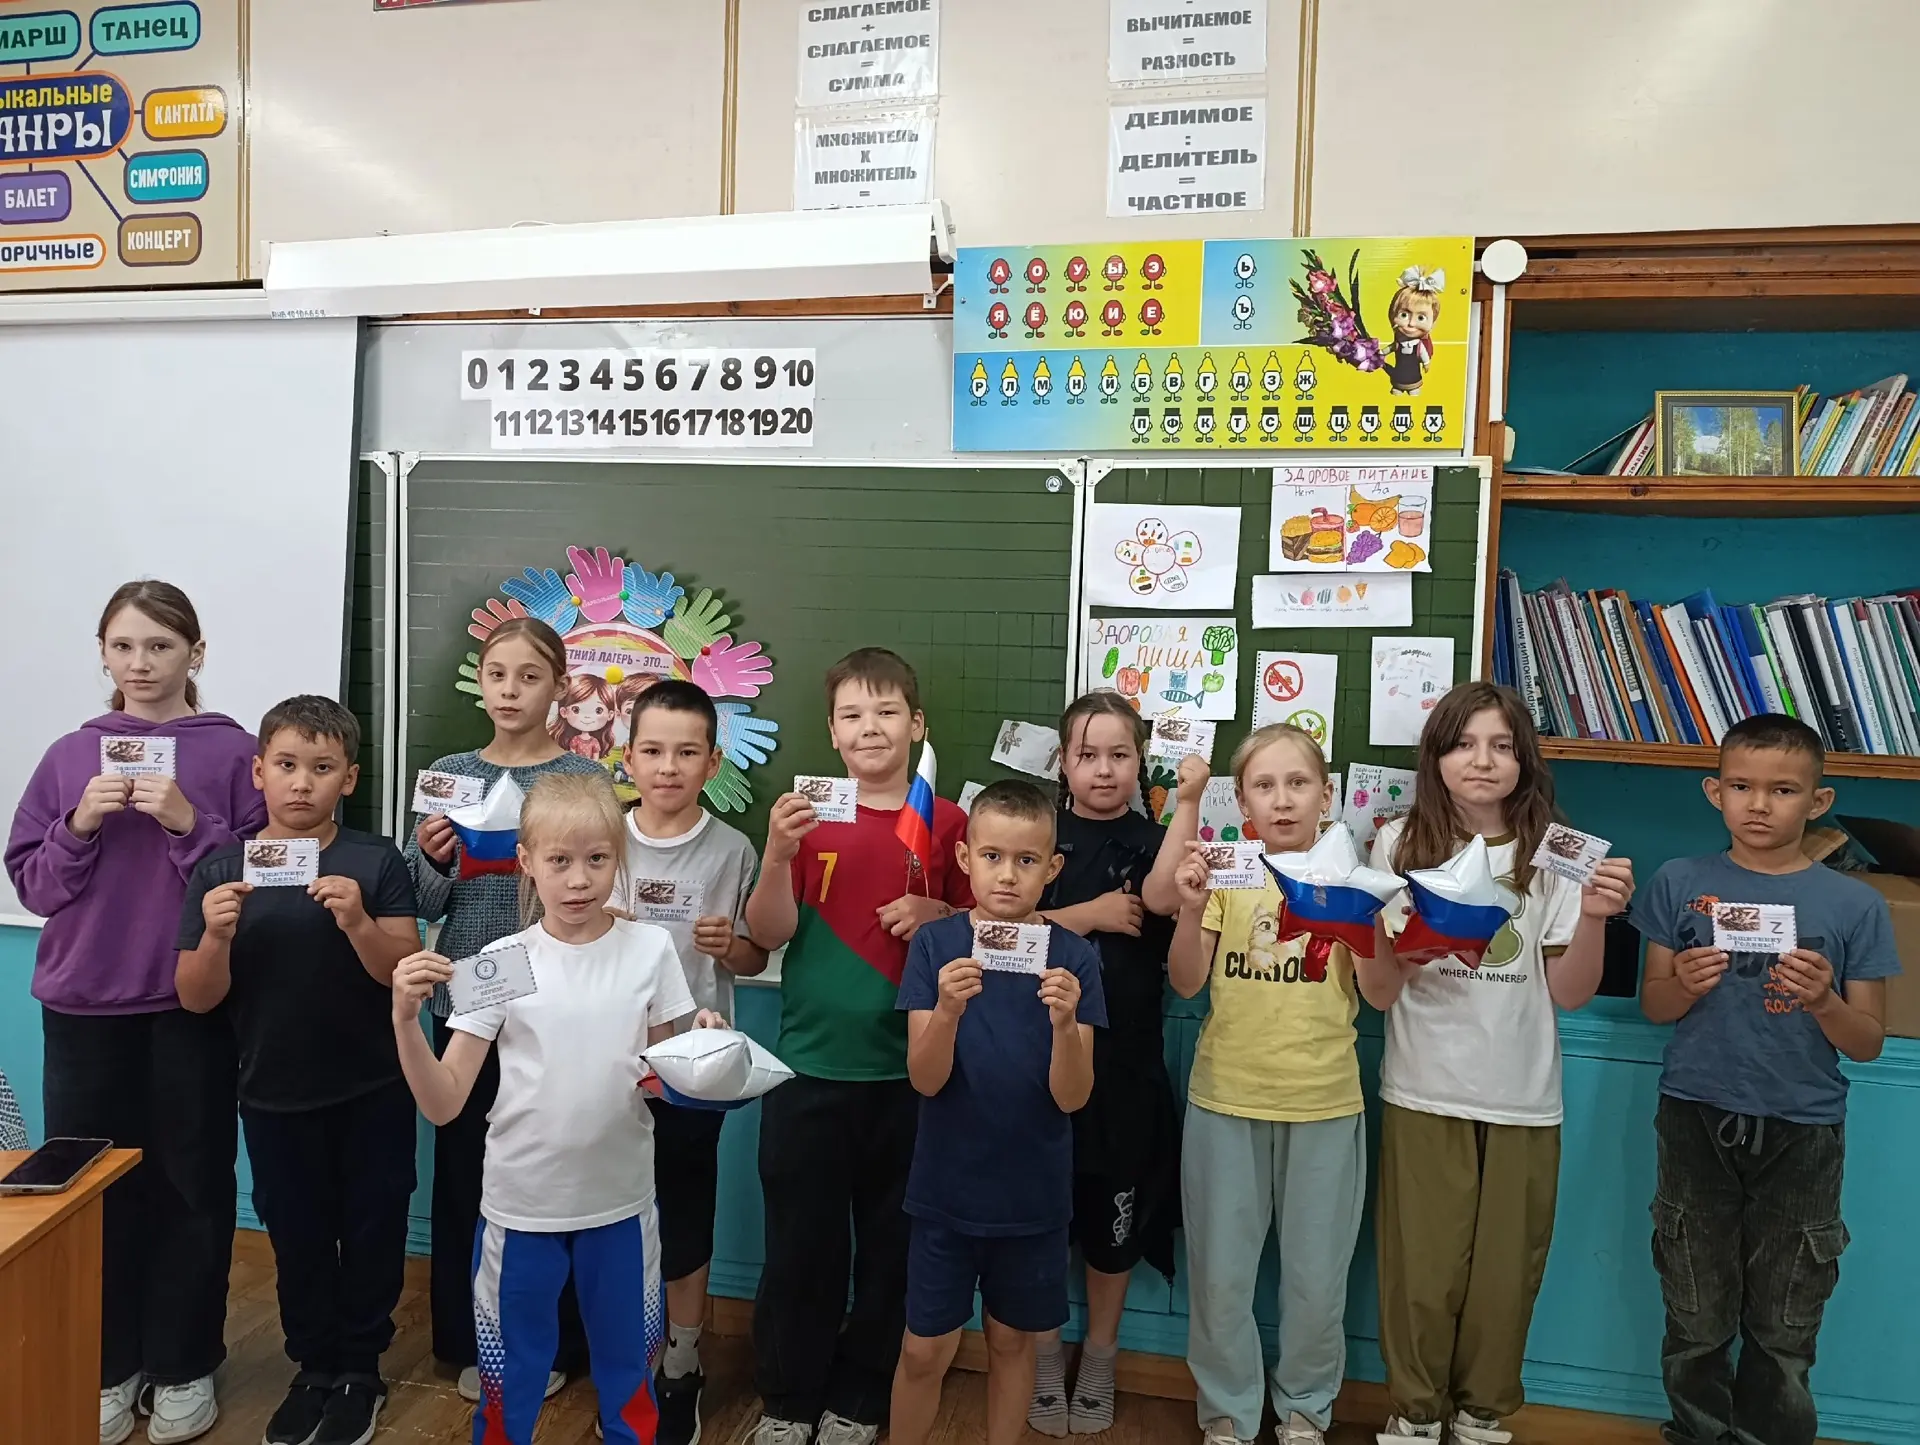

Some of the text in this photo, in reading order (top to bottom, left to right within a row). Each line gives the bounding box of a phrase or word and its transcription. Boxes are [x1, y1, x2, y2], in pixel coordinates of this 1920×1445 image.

[808, 0, 930, 22] СЛАГАЕМОЕ
[1127, 10, 1252, 33] ВЫЧИТАЕМОЕ
[807, 34, 930, 58] СЛАГАЕМОЕ
[1142, 52, 1236, 71] РАЗНОСТЬ
[828, 73, 905, 92] СУММА
[154, 103, 215, 125] КАНТАТА
[1125, 106, 1253, 130] ДЕЛИМОЕ
[815, 130, 919, 148] МНОЖИТЕЛЬ
[1118, 148, 1258, 172] ДЕЛИТЕЛЬ
[130, 165, 202, 188] СИМФОНИЯ
[814, 166, 918, 185] МНОЖИТЕЛЬ
[5, 187, 57, 209] БАЛЕТ
[1128, 191, 1246, 212] ЧАСТНОЕ
[127, 229, 191, 251] КОНЦЕРТ
[995, 262, 1159, 277] А О У Ы Э
[1241, 261, 1251, 273] Ь
[994, 307, 1156, 321] Я Ё Ю И Е
[1237, 302, 1250, 314] Ъ
[467, 356, 813, 391] 0 1 2 3 4 5 6 7 8 9 10
[975, 374, 1312, 392] Р Л М Н Й Б В Г Д З Ж
[494, 407, 812, 436] 11 12 13 14 15 16 17 18 19 20
[1137, 416, 1439, 429] П Ф К Т С Ш Ц Ч Щ Х
[1358, 468, 1429, 480] ПИТАНИЕ
[1516, 617, 1526, 640] мир
[566, 647, 595, 662] ТНИЙ
[598, 651, 633, 665] ЛАГЕРЬ
[1136, 644, 1204, 670] ПИЩА
[1608, 608, 1639, 692] ТЕСТИРОВАНИЕ
[818, 853, 837, 903] 7
[1225, 951, 1327, 983] CUIOU
